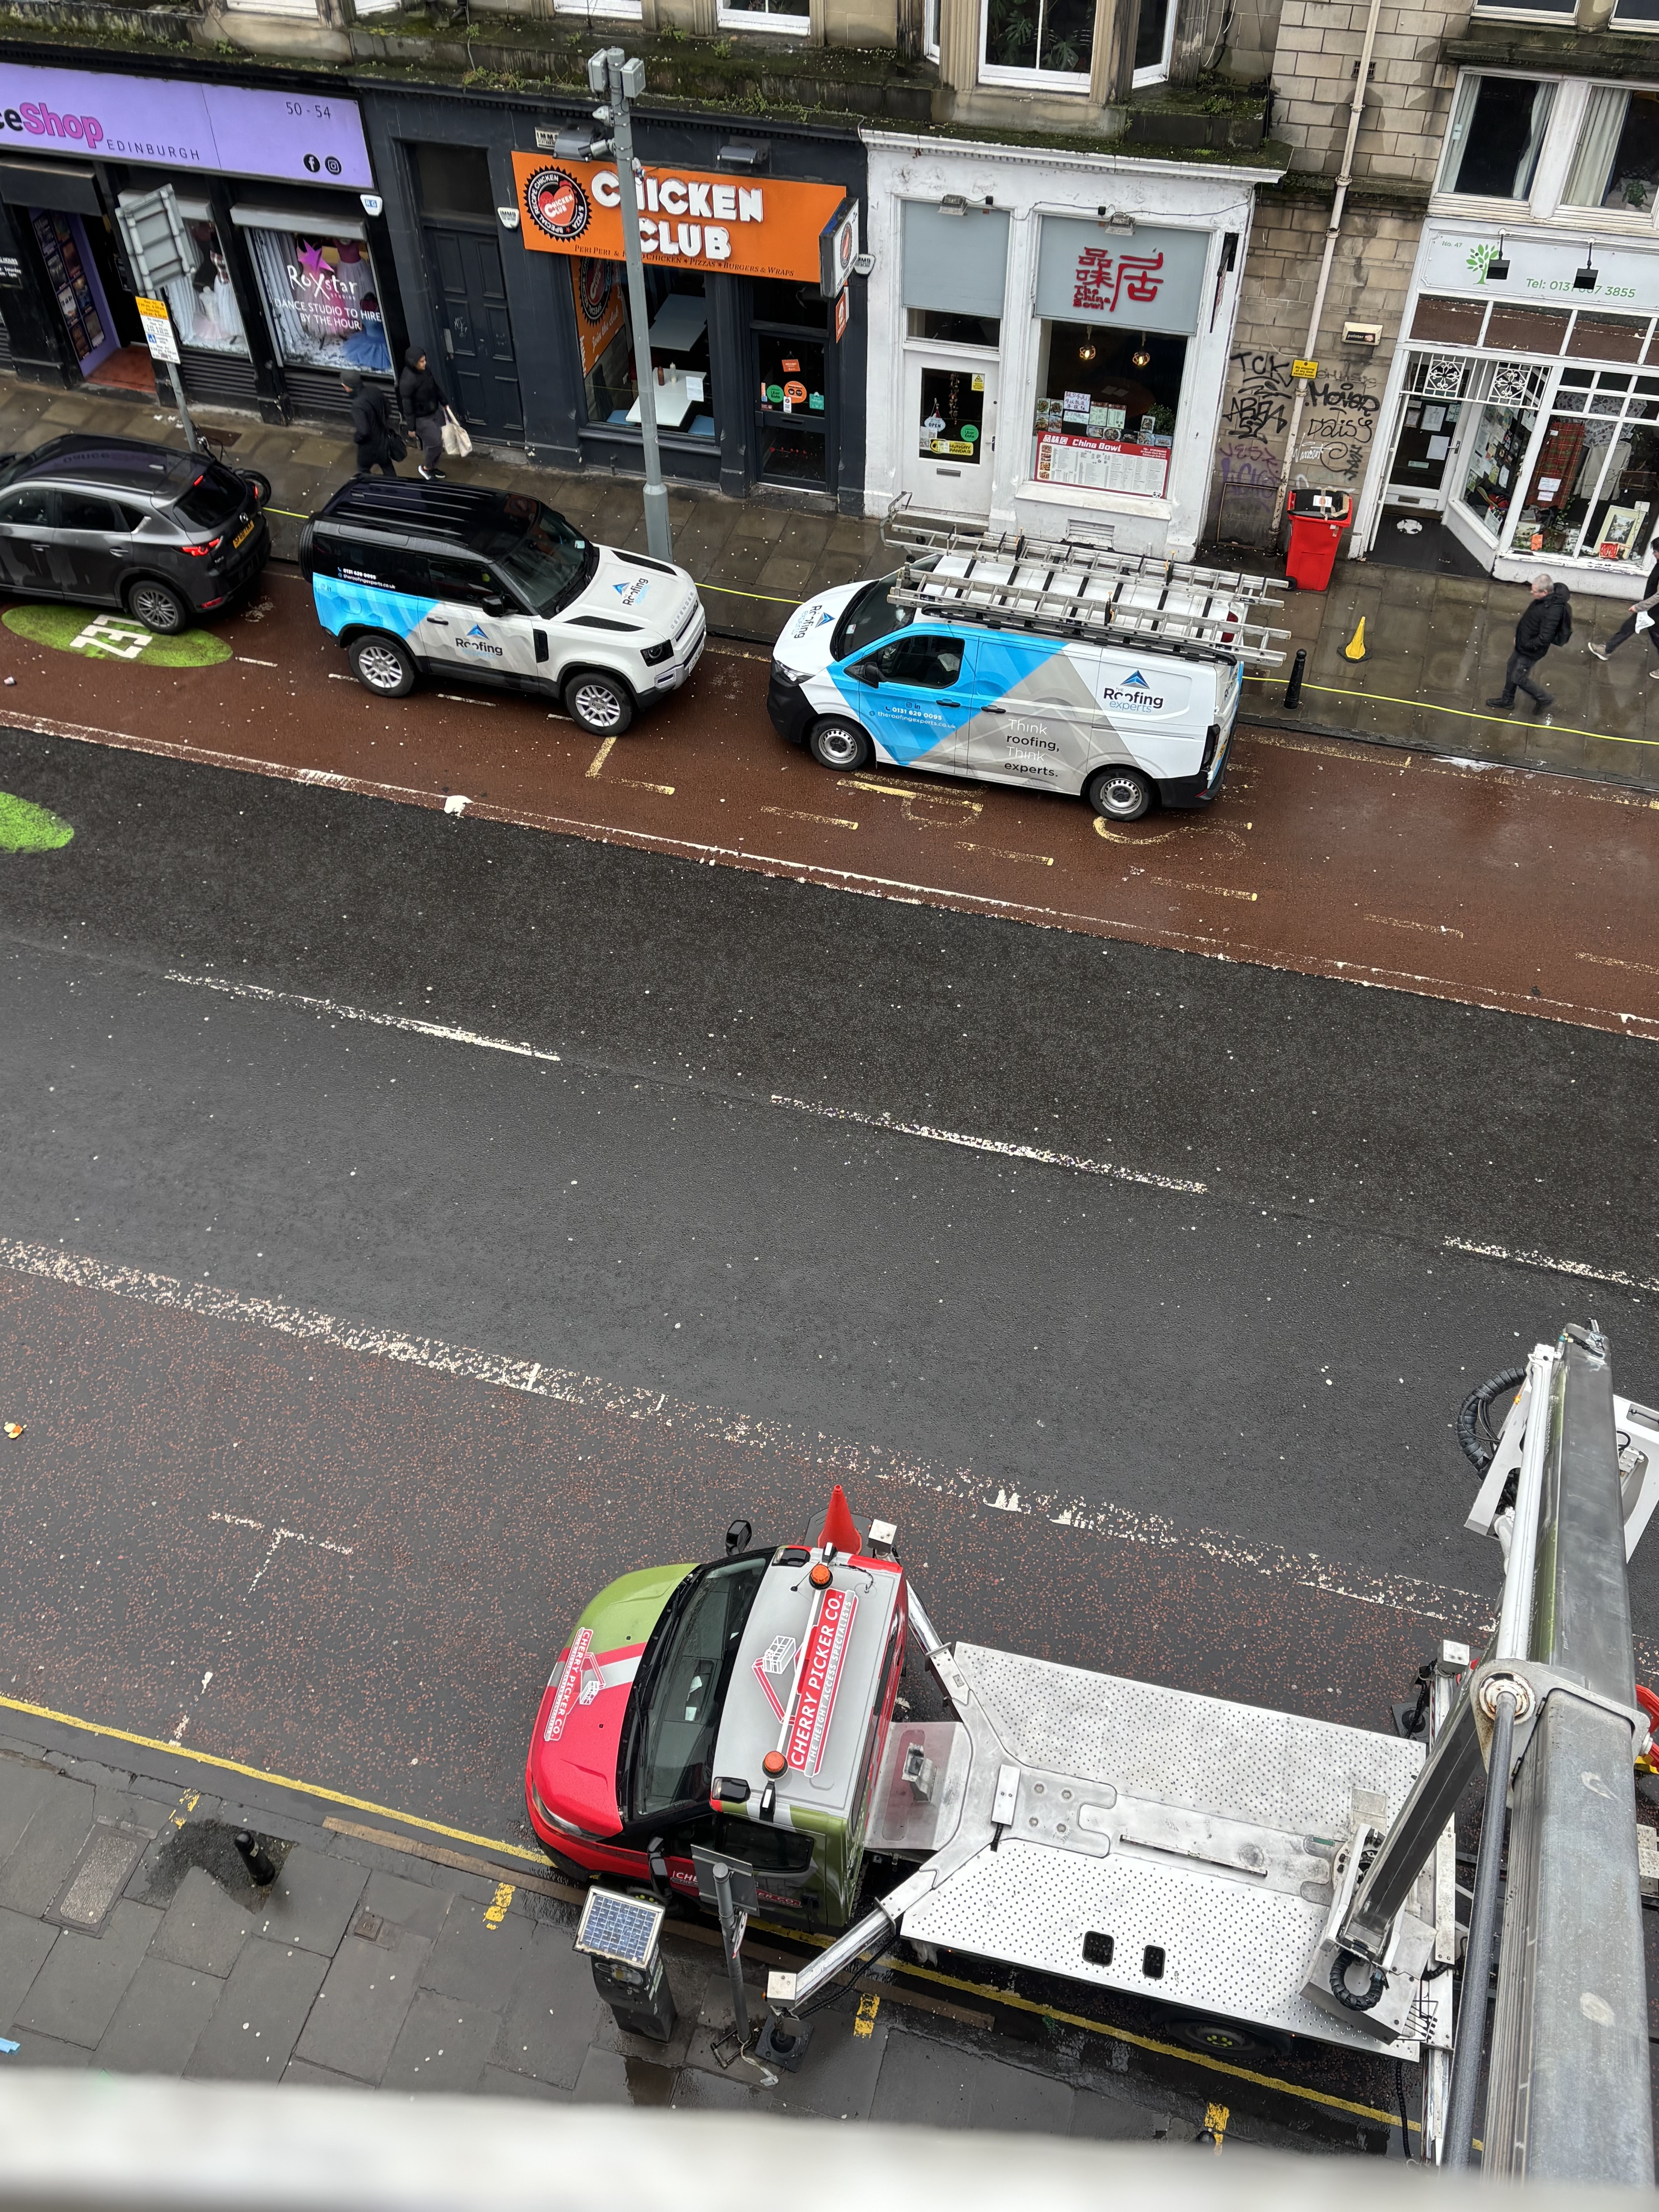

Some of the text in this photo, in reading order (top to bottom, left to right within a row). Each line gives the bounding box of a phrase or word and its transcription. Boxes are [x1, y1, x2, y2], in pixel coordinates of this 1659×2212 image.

[286, 101, 302, 116] 50
[315, 105, 331, 119] 54
[106, 139, 200, 161] EDINBURGH
[534, 174, 559, 189] CHICKEN
[531, 188, 541, 215] RECIPE
[544, 194, 574, 218] CHICKEN
[539, 215, 564, 234] SPECIAL
[572, 212, 584, 229] PIZZA
[575, 244, 591, 254] PERI
[594, 246, 610, 256] PERI
[646, 253, 681, 264] CHICKEN
[690, 258, 716, 268] PIZZAS
[723, 261, 759, 273] BURGERS
[768, 266, 794, 276] WRAPS
[1074, 285, 1099, 295] The
[1526, 278, 1546, 289] Tel:
[1605, 286, 1636, 298] 3855
[1073, 299, 1104, 310] Bowl
[1074, 293, 1111, 303] China
[275, 298, 382, 322] DANCE STUDIO TO HIRE
[300, 313, 361, 330] BY THE HOUR
[592, 332, 601, 354] Join
[609, 305, 619, 326] club
[1072, 438, 1122, 452] China Bowl
[622, 578, 649, 606] Roofing
[670, 591, 694, 630] DEFENDER
[793, 605, 823, 639] Roofing
[455, 637, 503, 656] Roofing
[1103, 687, 1164, 709] Roofing
[1109, 700, 1152, 713] experts
[878, 711, 956, 729] theroofingexperts.co.uk
[923, 712, 942, 720] 0095
[1008, 718, 1048, 735] Think
[1006, 735, 1060, 752] roofing,
[1006, 746, 1045, 761] Think
[1004, 763, 1058, 777] experts.
[572, 1631, 590, 1673] CHERRY
[791, 1594, 843, 1766] CHERRY PICKER CO.
[808, 1601, 851, 1764] THE HEIGHT ACCESS SPECIALISTS
[558, 1675, 576, 1716] PICKER
[551, 1719, 562, 1737] CO.
